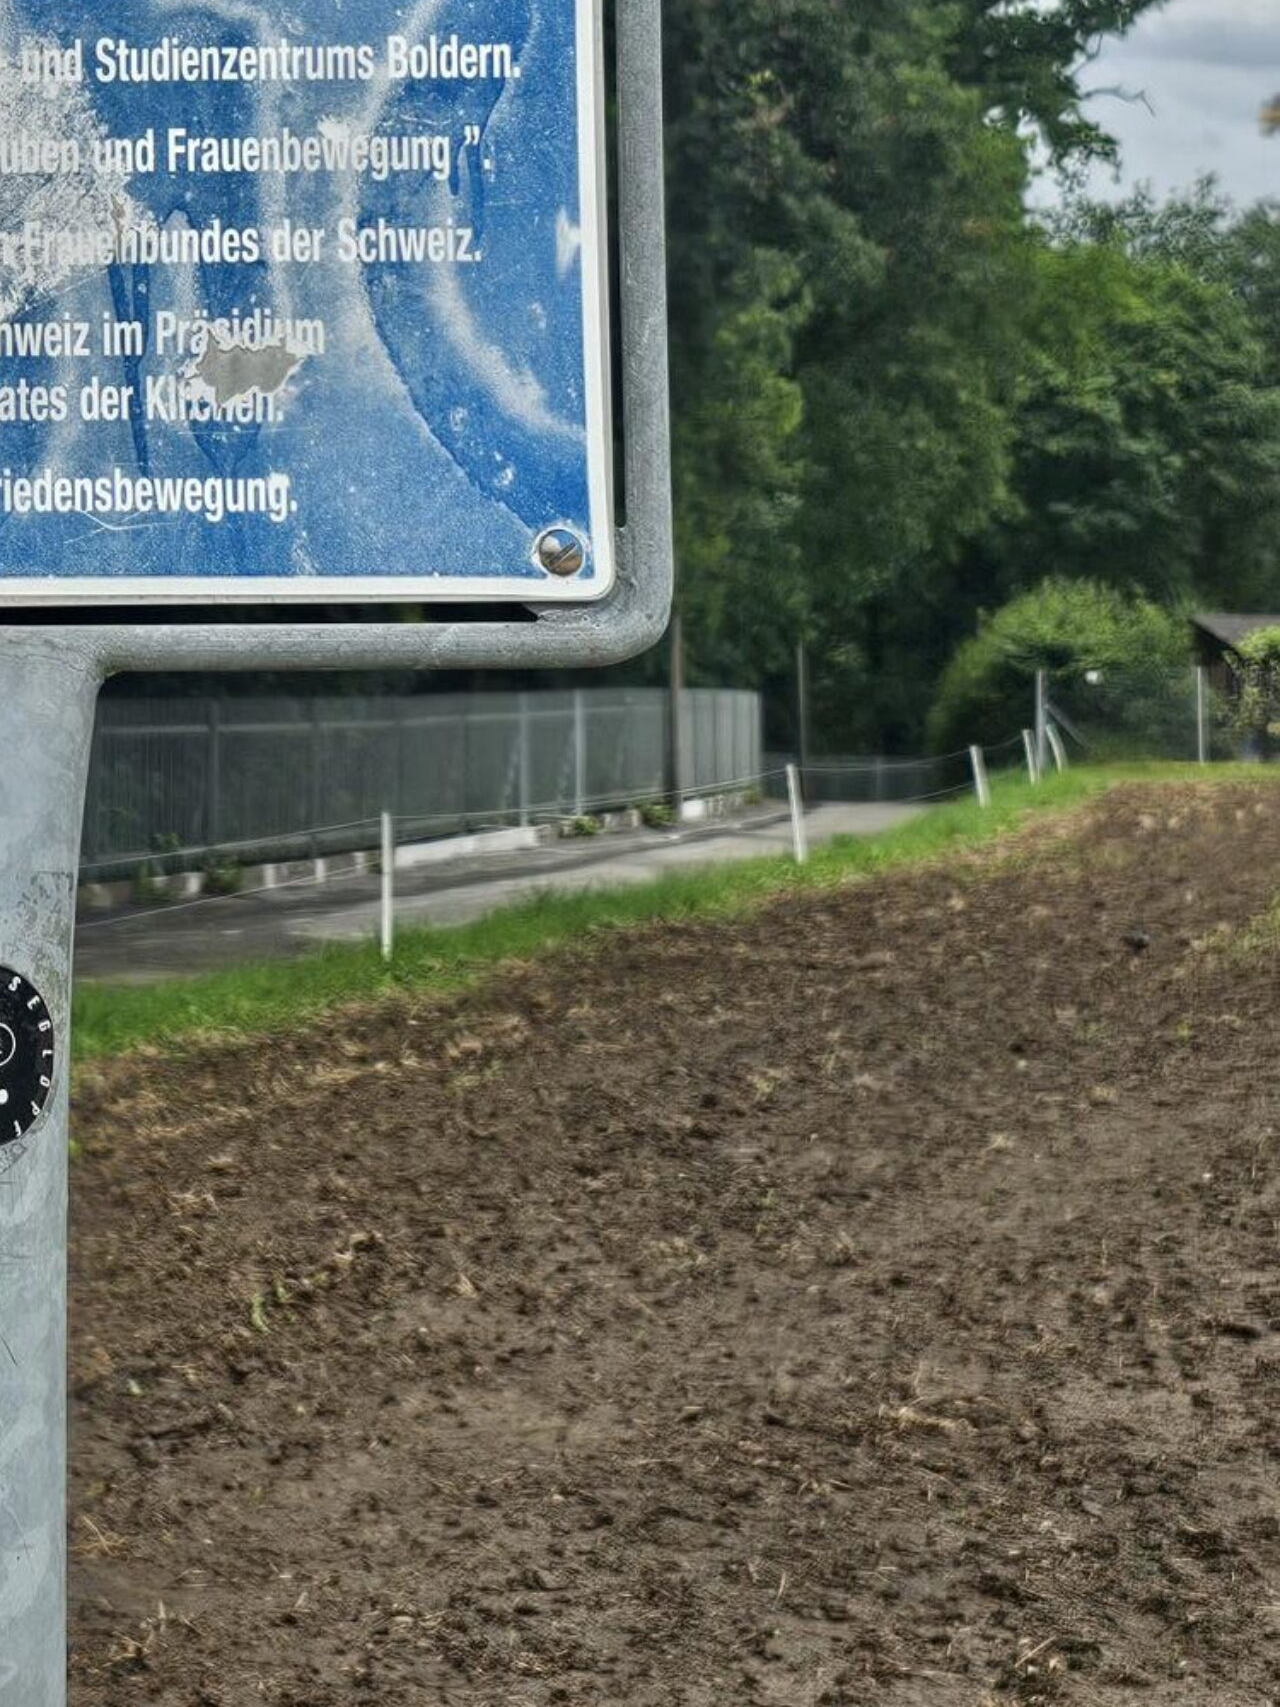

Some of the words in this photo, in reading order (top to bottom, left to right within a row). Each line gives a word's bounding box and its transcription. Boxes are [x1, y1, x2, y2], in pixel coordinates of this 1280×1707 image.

[20, 37, 83, 84] und
[94, 36, 374, 82] Studienzentrums
[386, 34, 521, 80] Boldern.
[93, 128, 155, 174] und
[167, 125, 450, 181] Frauenbewegung
[271, 218, 322, 263] der
[338, 217, 483, 263] Schweiz.
[103, 311, 143, 356] im
[155, 308, 326, 357] Präsidium
[79, 377, 134, 421] der
